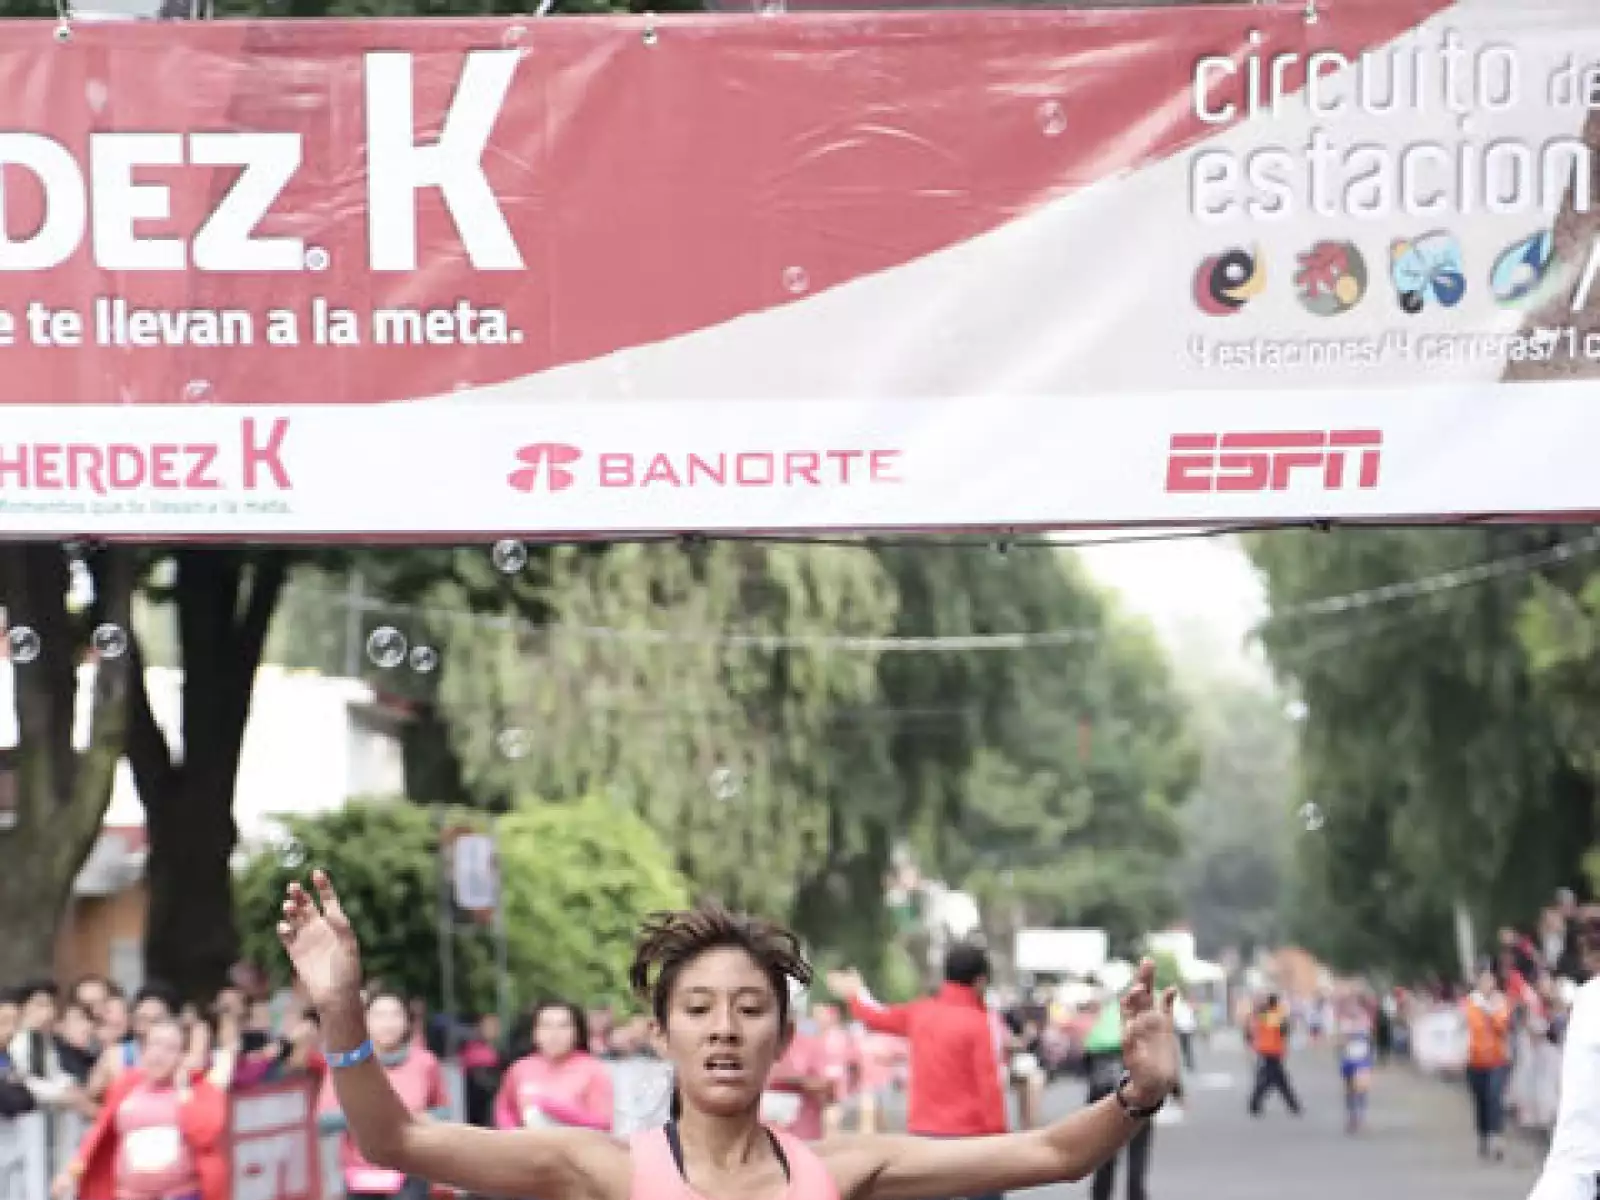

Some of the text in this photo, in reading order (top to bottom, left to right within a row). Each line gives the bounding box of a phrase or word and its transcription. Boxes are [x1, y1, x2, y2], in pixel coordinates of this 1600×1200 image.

[1194, 29, 1517, 124] circuito
[364, 48, 527, 271] K
[26, 301, 83, 346] te
[95, 298, 254, 346] llevan
[266, 307, 299, 346] a
[312, 298, 360, 346] la
[372, 300, 524, 346] meta.
[0, 416, 293, 497] HERDEZ K
[598, 448, 905, 487] BANORTE
[1164, 429, 1384, 492] ESPN
